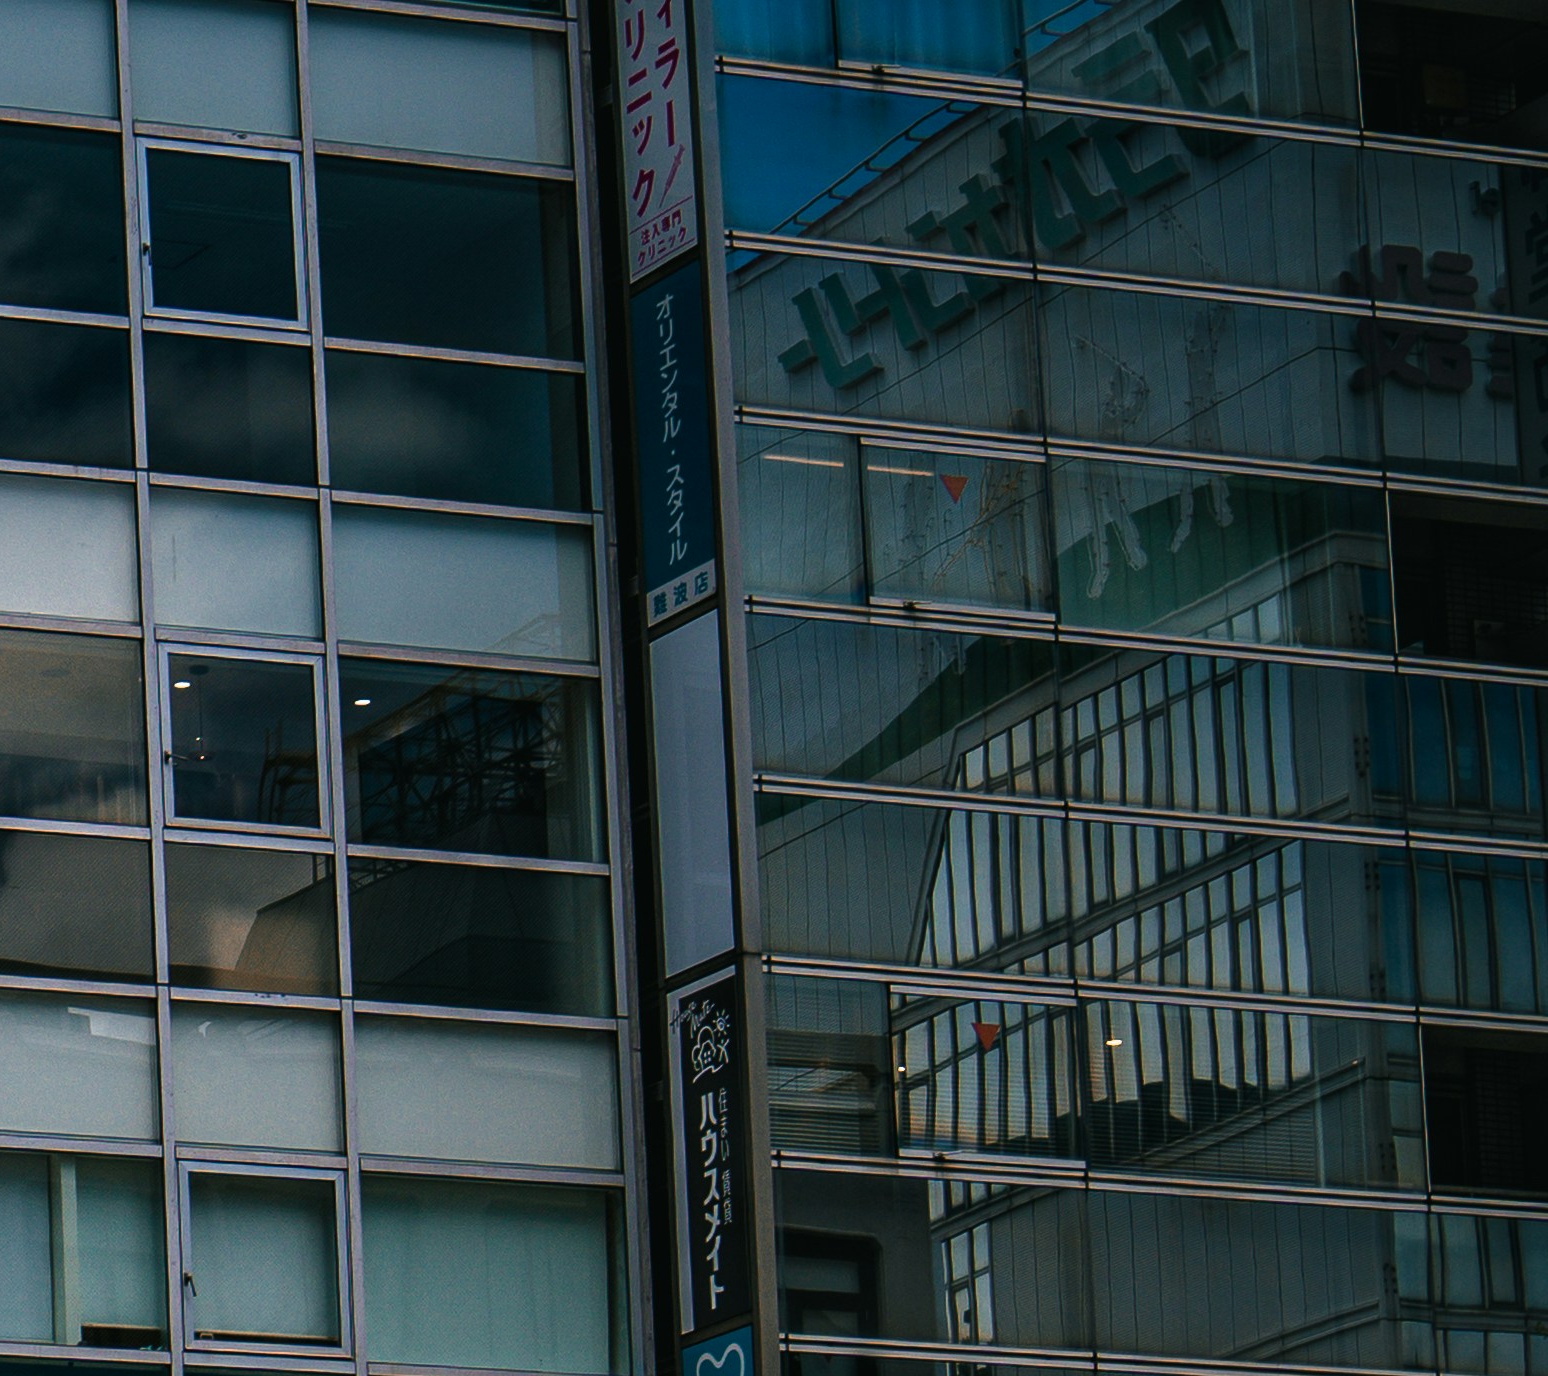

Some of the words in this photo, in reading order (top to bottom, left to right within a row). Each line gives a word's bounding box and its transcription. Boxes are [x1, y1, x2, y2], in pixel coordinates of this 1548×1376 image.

[624, 0, 654, 218] リニック
[638, 228, 687, 266] クリニック
[656, 294, 688, 567] オリエンタル・スタイル
[700, 1090, 725, 1310] ハウスメイト
